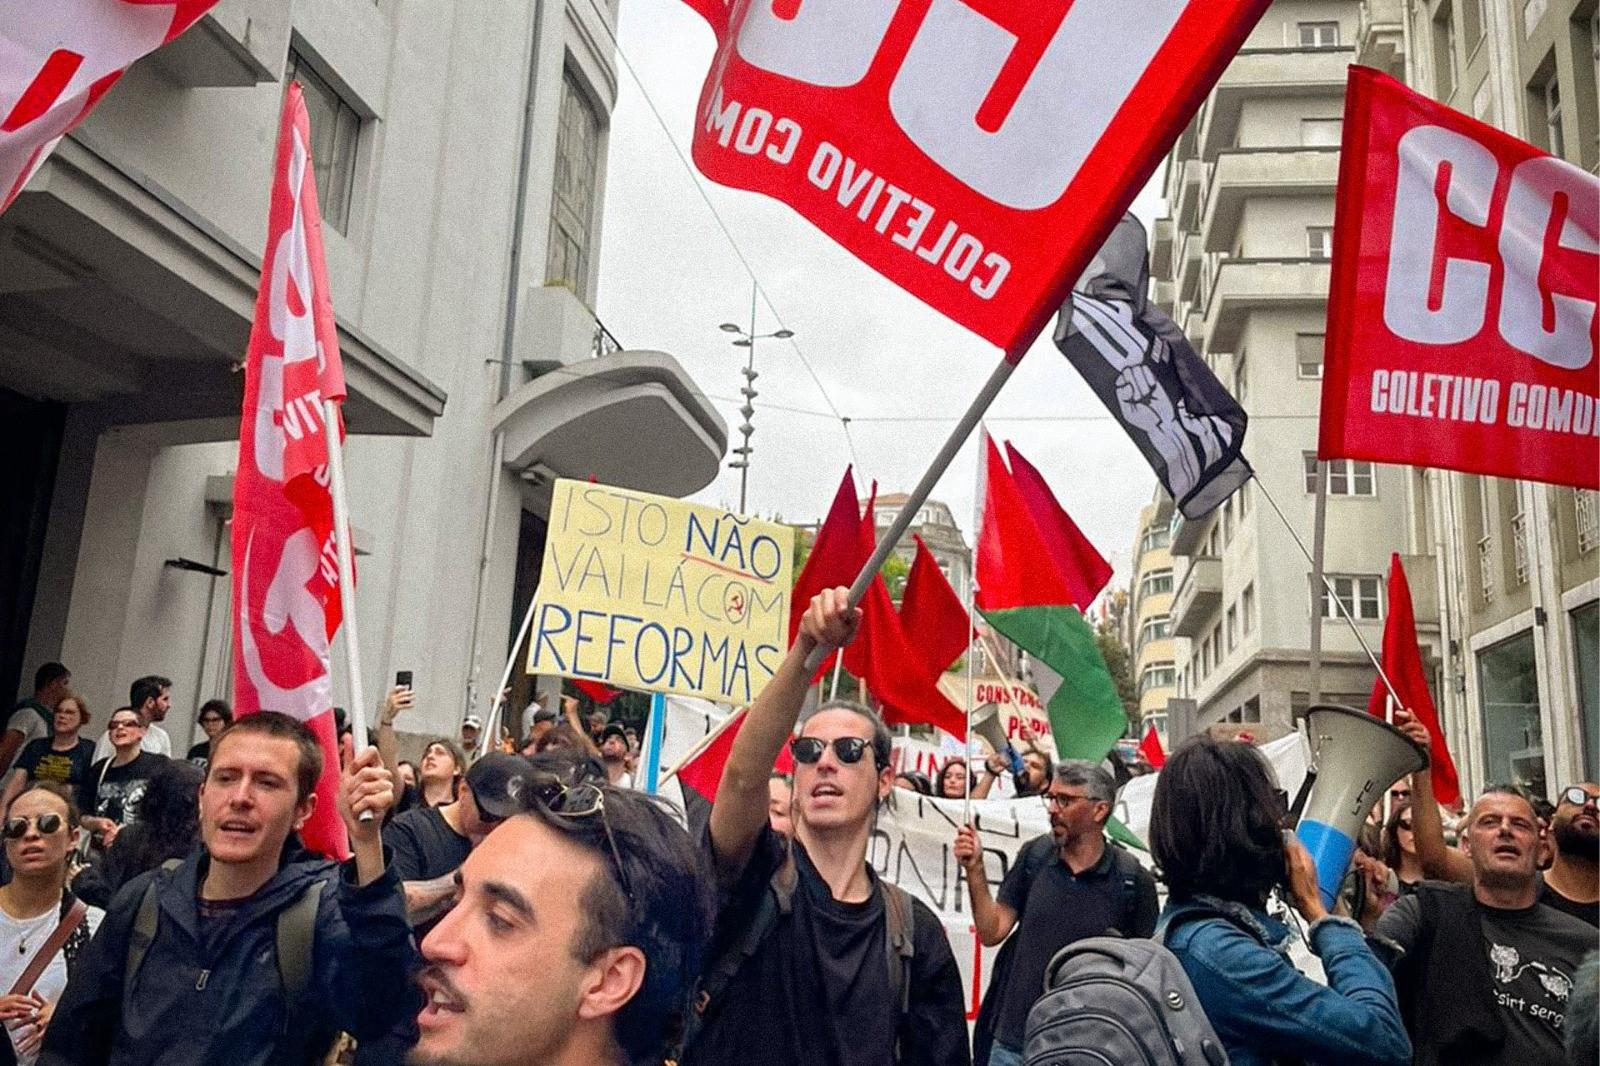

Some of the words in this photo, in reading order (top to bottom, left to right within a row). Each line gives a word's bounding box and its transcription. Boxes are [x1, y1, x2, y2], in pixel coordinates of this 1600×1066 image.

[1371, 369, 1500, 424] COLETIVO
[563, 488, 667, 546] ISTO
[686, 512, 782, 579] NÃO
[551, 542, 626, 600] VAI
[643, 557, 690, 616] LÁ
[697, 574, 783, 641] COM
[532, 603, 779, 701] REFORMAS
